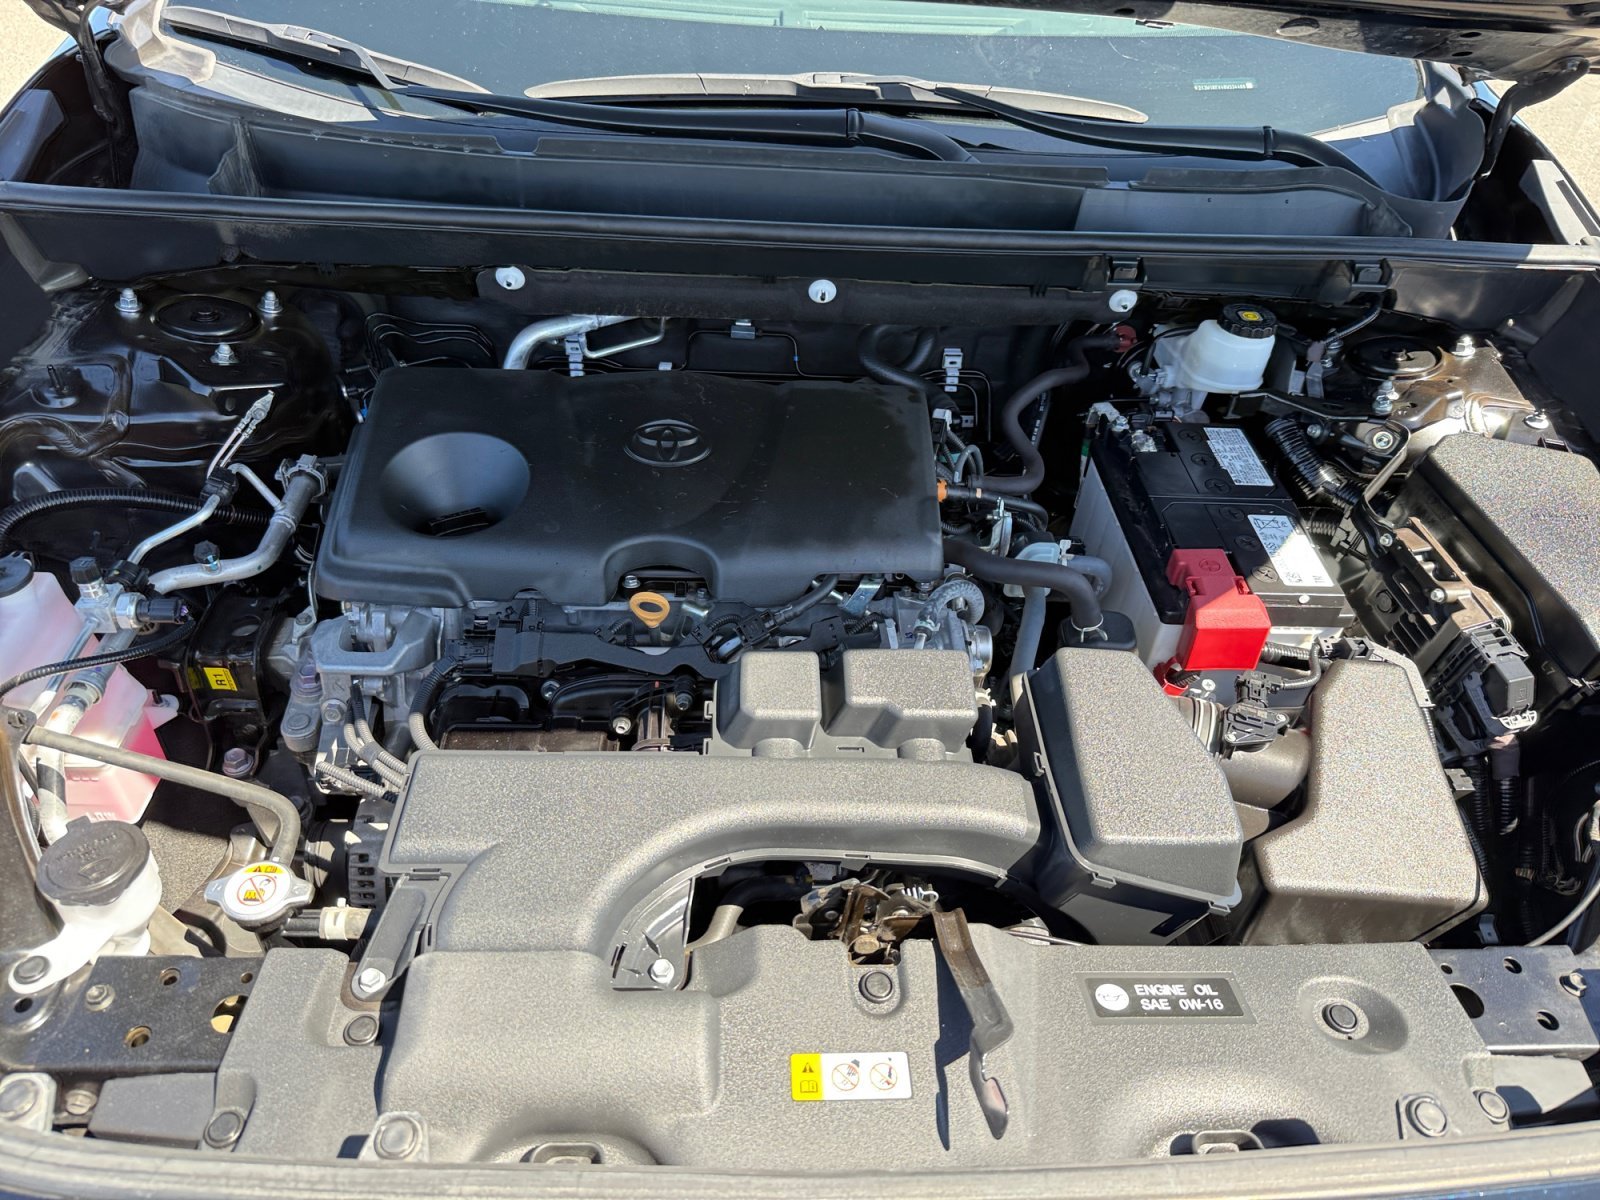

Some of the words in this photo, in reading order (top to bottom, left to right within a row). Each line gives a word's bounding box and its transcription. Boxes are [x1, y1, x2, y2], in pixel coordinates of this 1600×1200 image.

[1134, 984, 1187, 996] ENGINE
[1193, 984, 1218, 996] OIL
[1140, 998, 1171, 1011] SAE
[1178, 998, 1224, 1011] 0W-16
